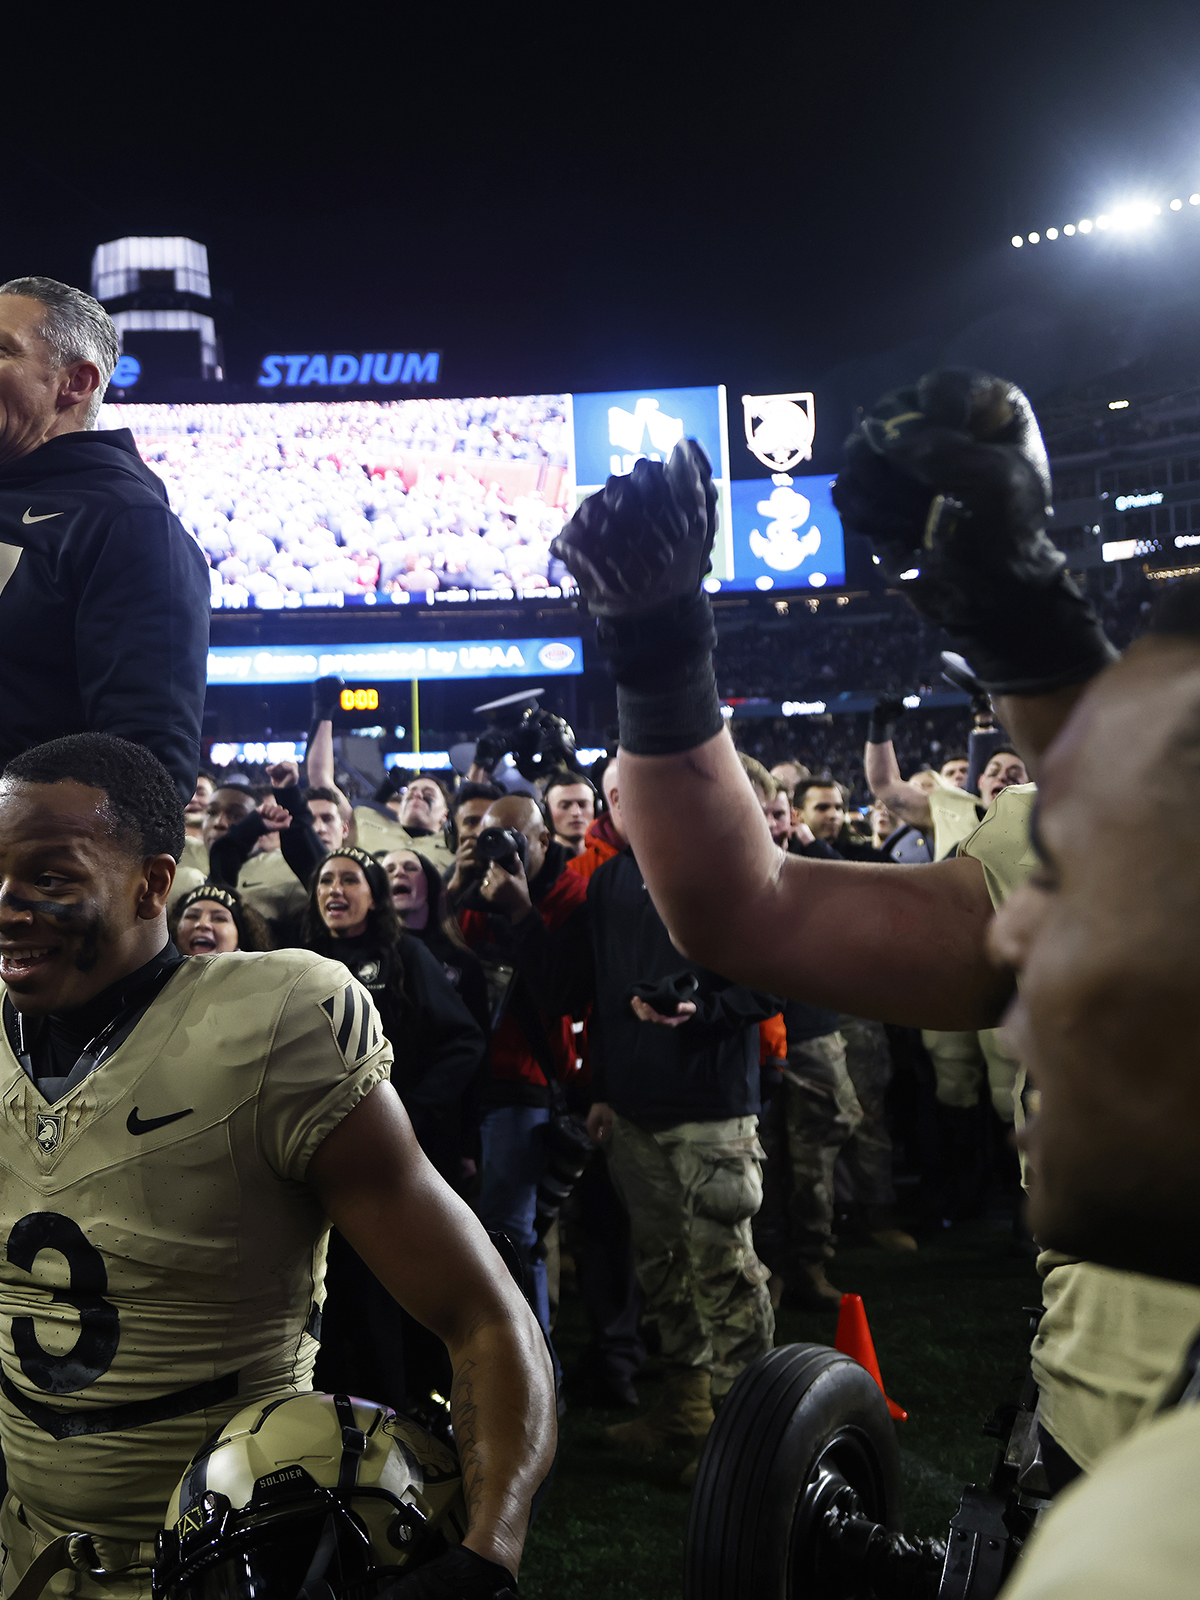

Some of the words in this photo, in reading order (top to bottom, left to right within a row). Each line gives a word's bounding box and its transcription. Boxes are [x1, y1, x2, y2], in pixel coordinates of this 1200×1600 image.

[257, 353, 440, 387] STADIUM
[459, 645, 525, 669] USAA
[186, 886, 236, 907] ARMY
[6, 1211, 120, 1394] 3
[259, 1468, 304, 1489] SOLDIER
